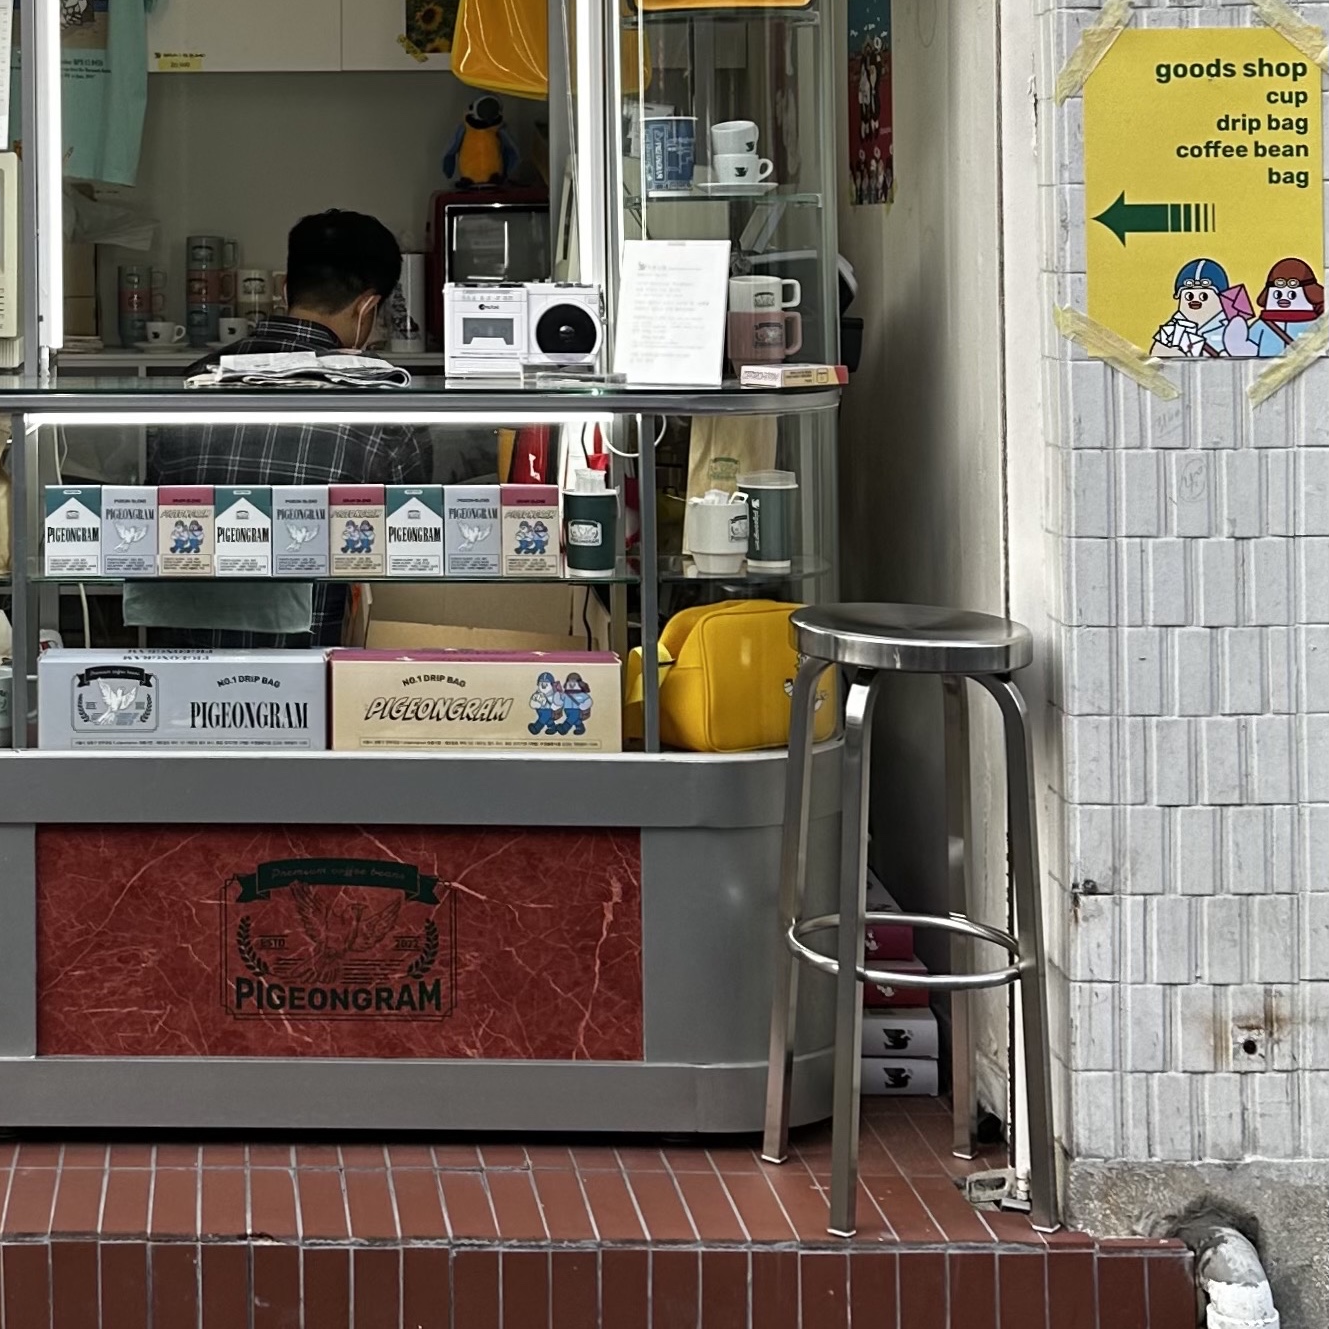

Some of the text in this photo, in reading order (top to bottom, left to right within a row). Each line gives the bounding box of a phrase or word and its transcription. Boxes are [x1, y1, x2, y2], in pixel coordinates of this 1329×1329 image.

[1155, 58, 1308, 83] goods shop
[1266, 89, 1308, 107] cup
[1216, 114, 1309, 134] drip bag
[1176, 141, 1309, 158] coffee bean
[1267, 167, 1310, 188] bag
[105, 508, 154, 520] PIGEONGRAM
[448, 507, 498, 520] PIGEONGRAM
[47, 526, 99, 543] PIGEONGRAM
[217, 526, 270, 543] PIGEONGRAM
[388, 526, 441, 543] PIGEONGRAM
[216, 675, 281, 688] NO.1 DRIP BAG
[402, 674, 466, 687] NO.1 DRIP BAG
[190, 701, 309, 729] PIGEONGRAM
[364, 697, 514, 721] PIGEONGRAM
[235, 976, 442, 1011] PIGEONGRAM
